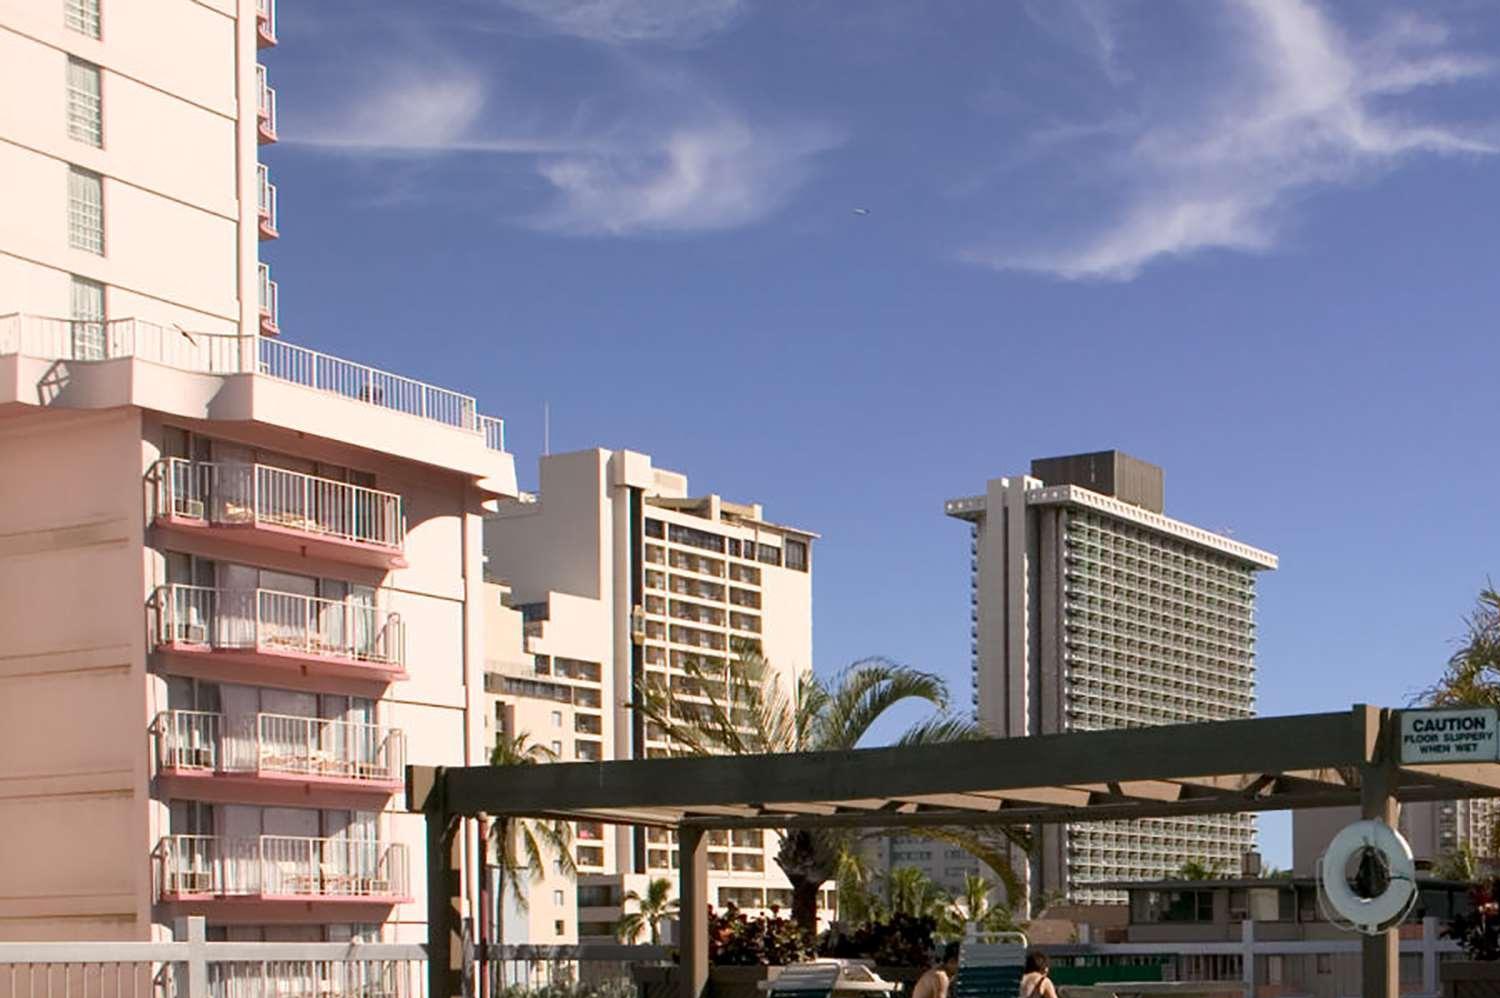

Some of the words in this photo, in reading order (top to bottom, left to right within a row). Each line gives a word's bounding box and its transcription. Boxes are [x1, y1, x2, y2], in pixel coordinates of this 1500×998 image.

[1413, 717, 1485, 732] CAUTION
[1404, 734, 1438, 743] FLOOR
[1444, 732, 1493, 742] SLIPPERY
[1420, 744, 1450, 754] WHEN
[1455, 743, 1478, 753] WET
